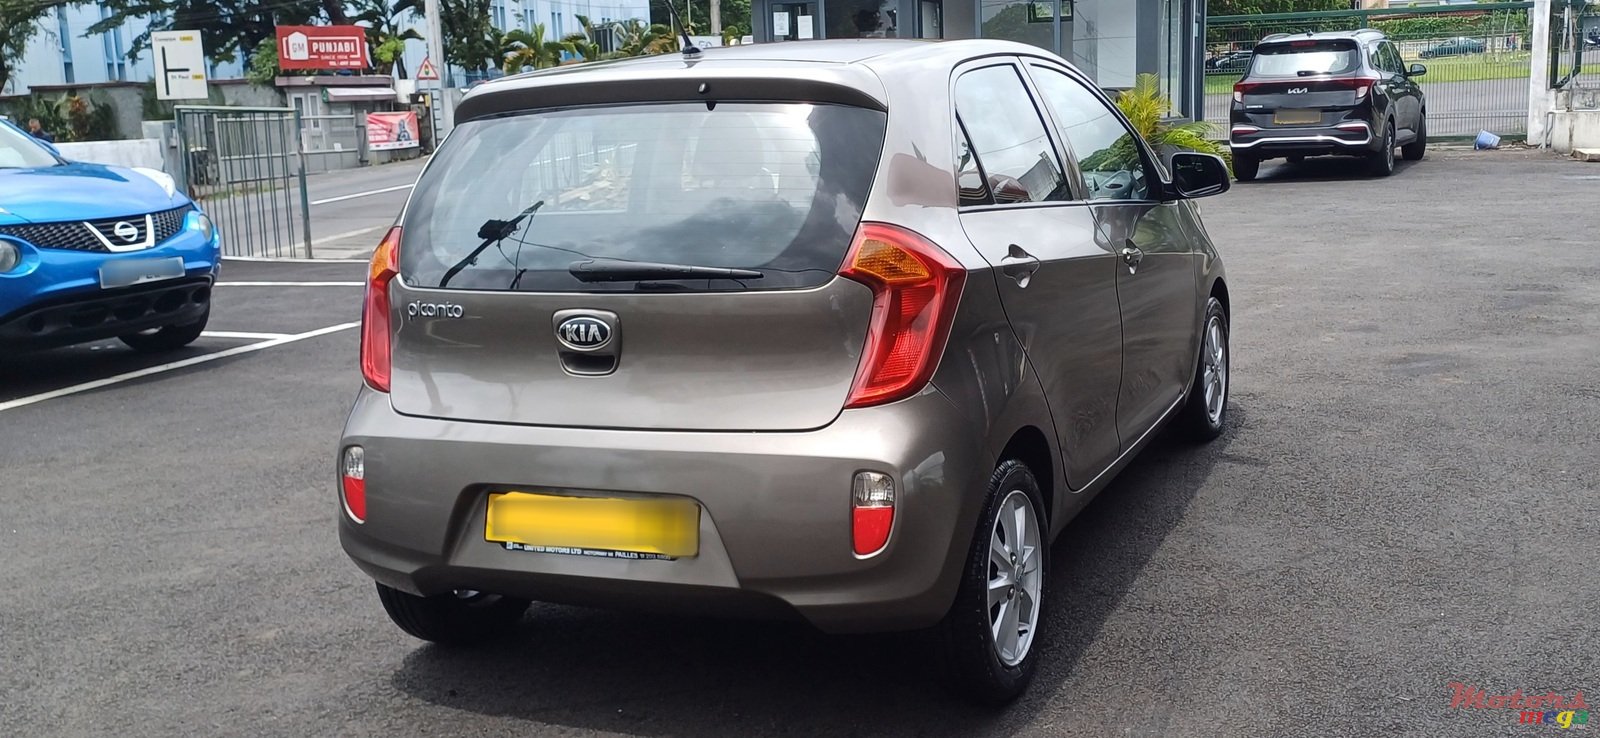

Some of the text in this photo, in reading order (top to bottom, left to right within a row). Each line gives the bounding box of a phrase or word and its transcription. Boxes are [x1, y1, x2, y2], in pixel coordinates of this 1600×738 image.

[292, 43, 305, 53] GM
[312, 41, 355, 53] PUNJABI
[408, 300, 463, 320] picanto
[565, 323, 602, 342] KIA
[524, 544, 545, 552] UNITED
[545, 546, 570, 554] MOTORS
[615, 551, 639, 559] PAILLES
